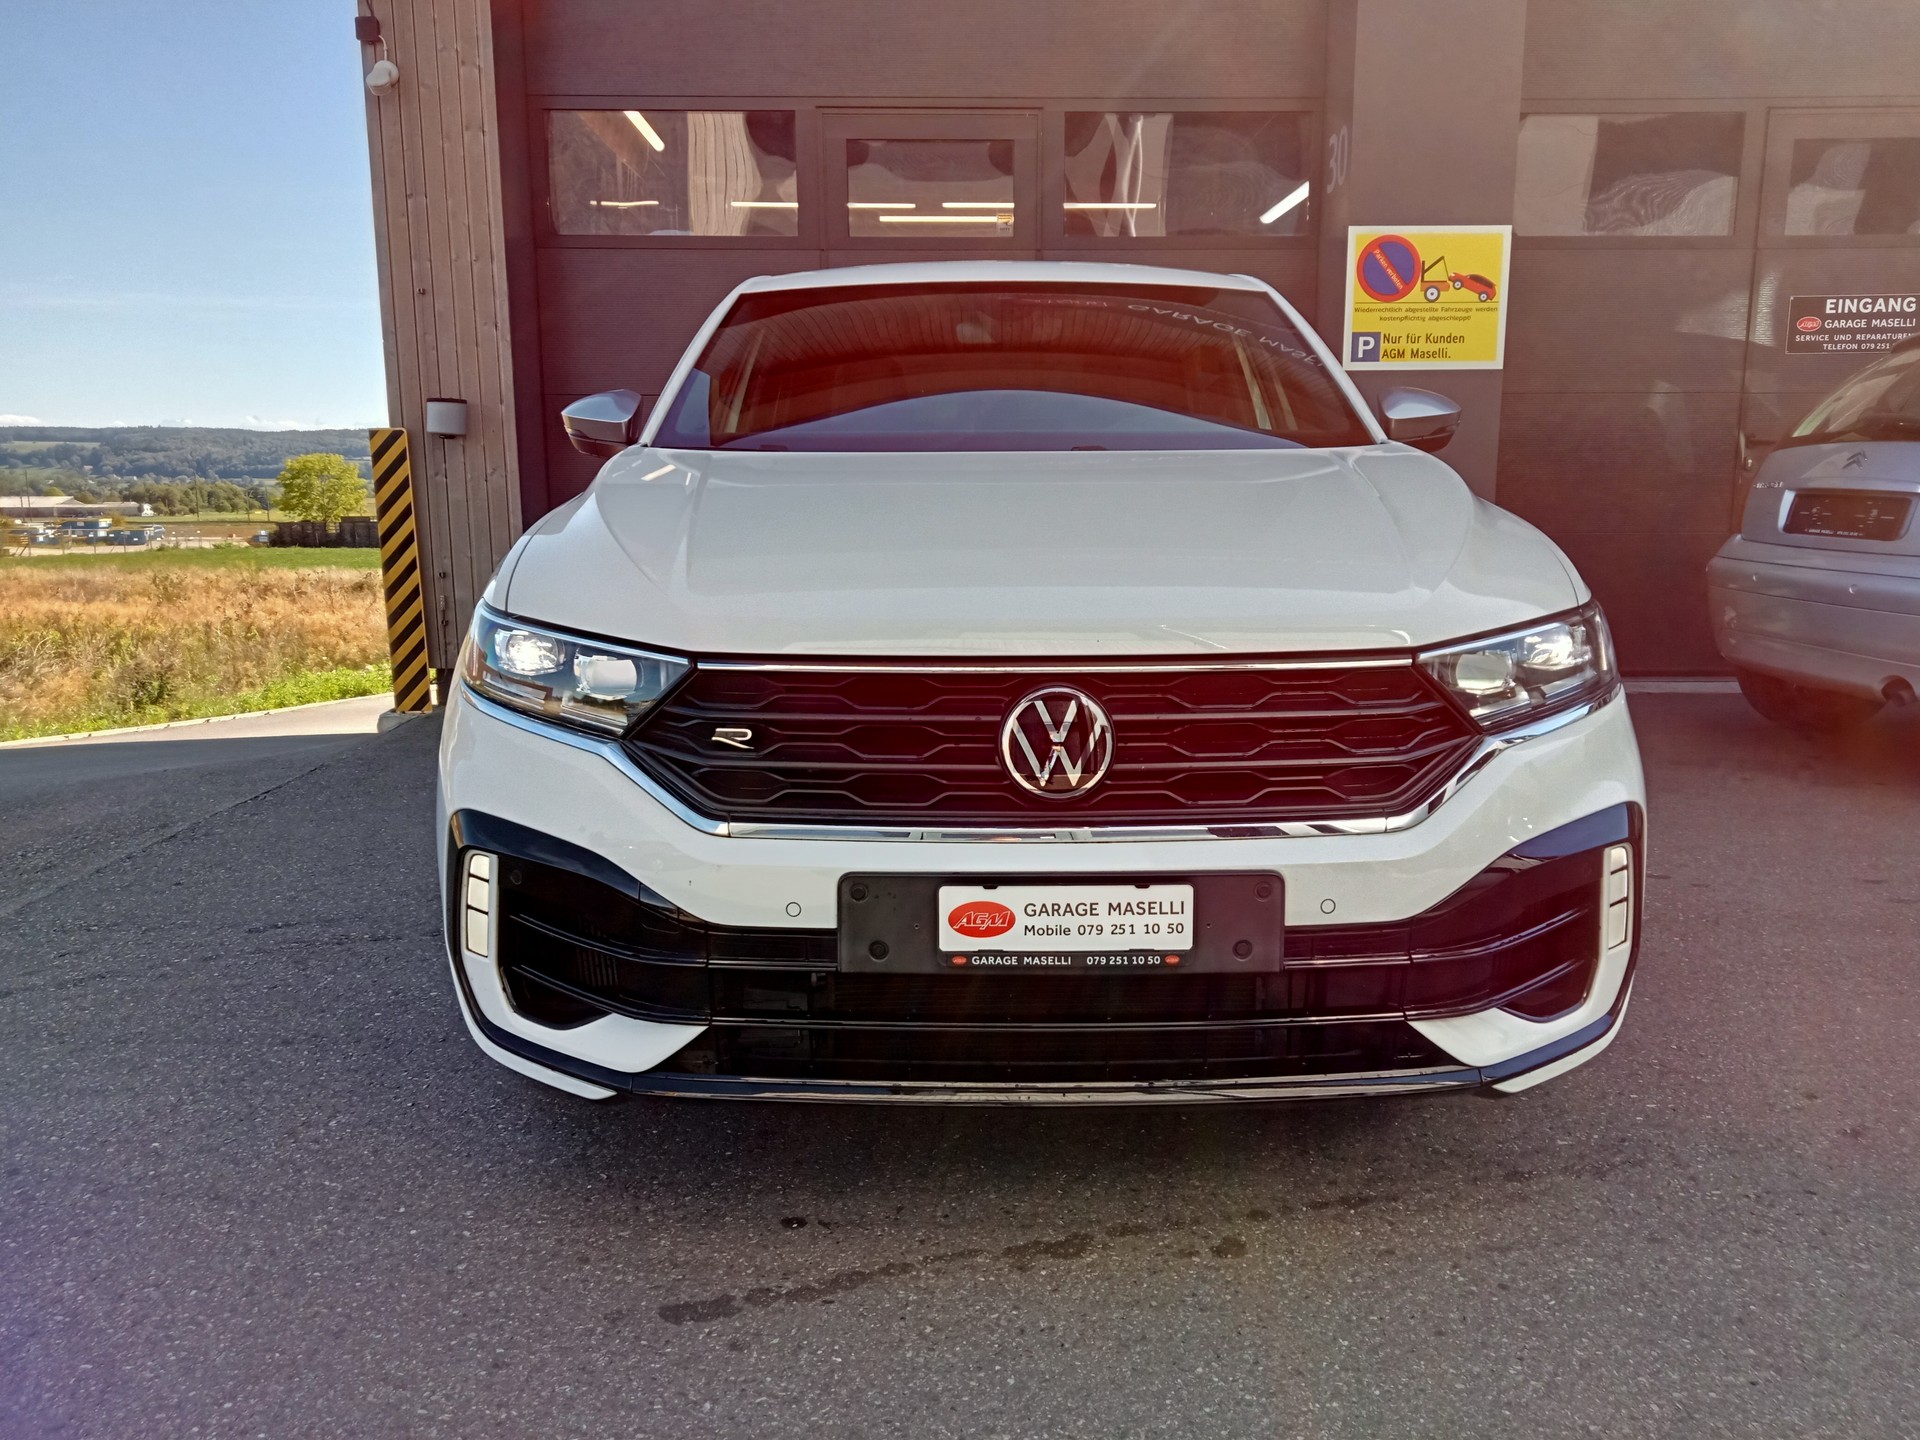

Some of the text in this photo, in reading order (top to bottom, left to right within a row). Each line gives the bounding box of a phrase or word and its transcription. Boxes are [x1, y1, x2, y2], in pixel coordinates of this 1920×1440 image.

[1326, 125, 1348, 194] 30
[1373, 249, 1403, 290] Parken verboten
[1441, 306, 1473, 314] Fahrzeuge
[1825, 297, 1917, 314] EINGANG
[1824, 318, 1916, 329] GARAGE MASELLI
[1382, 333, 1465, 345] Nur für Kunden
[1795, 334, 1830, 342] SERVICE
[1855, 332, 1914, 341] REPARATURE
[1357, 336, 1375, 358] P
[1381, 347, 1451, 359] AGM Maselli.
[1876, 342, 1890, 350] 251
[711, 727, 755, 749] R
[1023, 900, 1185, 918] GARAGE MASELLI
[952, 910, 1011, 931] AGM
[1024, 922, 1184, 937] Mobile 079 251 10 50
[971, 956, 1018, 965] GARAGE
[1023, 956, 1072, 965] MASELLI
[1086, 956, 1106, 965] 079
[1109, 956, 1128, 965] 251
[1132, 956, 1145, 965] 10
[1147, 955, 1161, 965] 50
